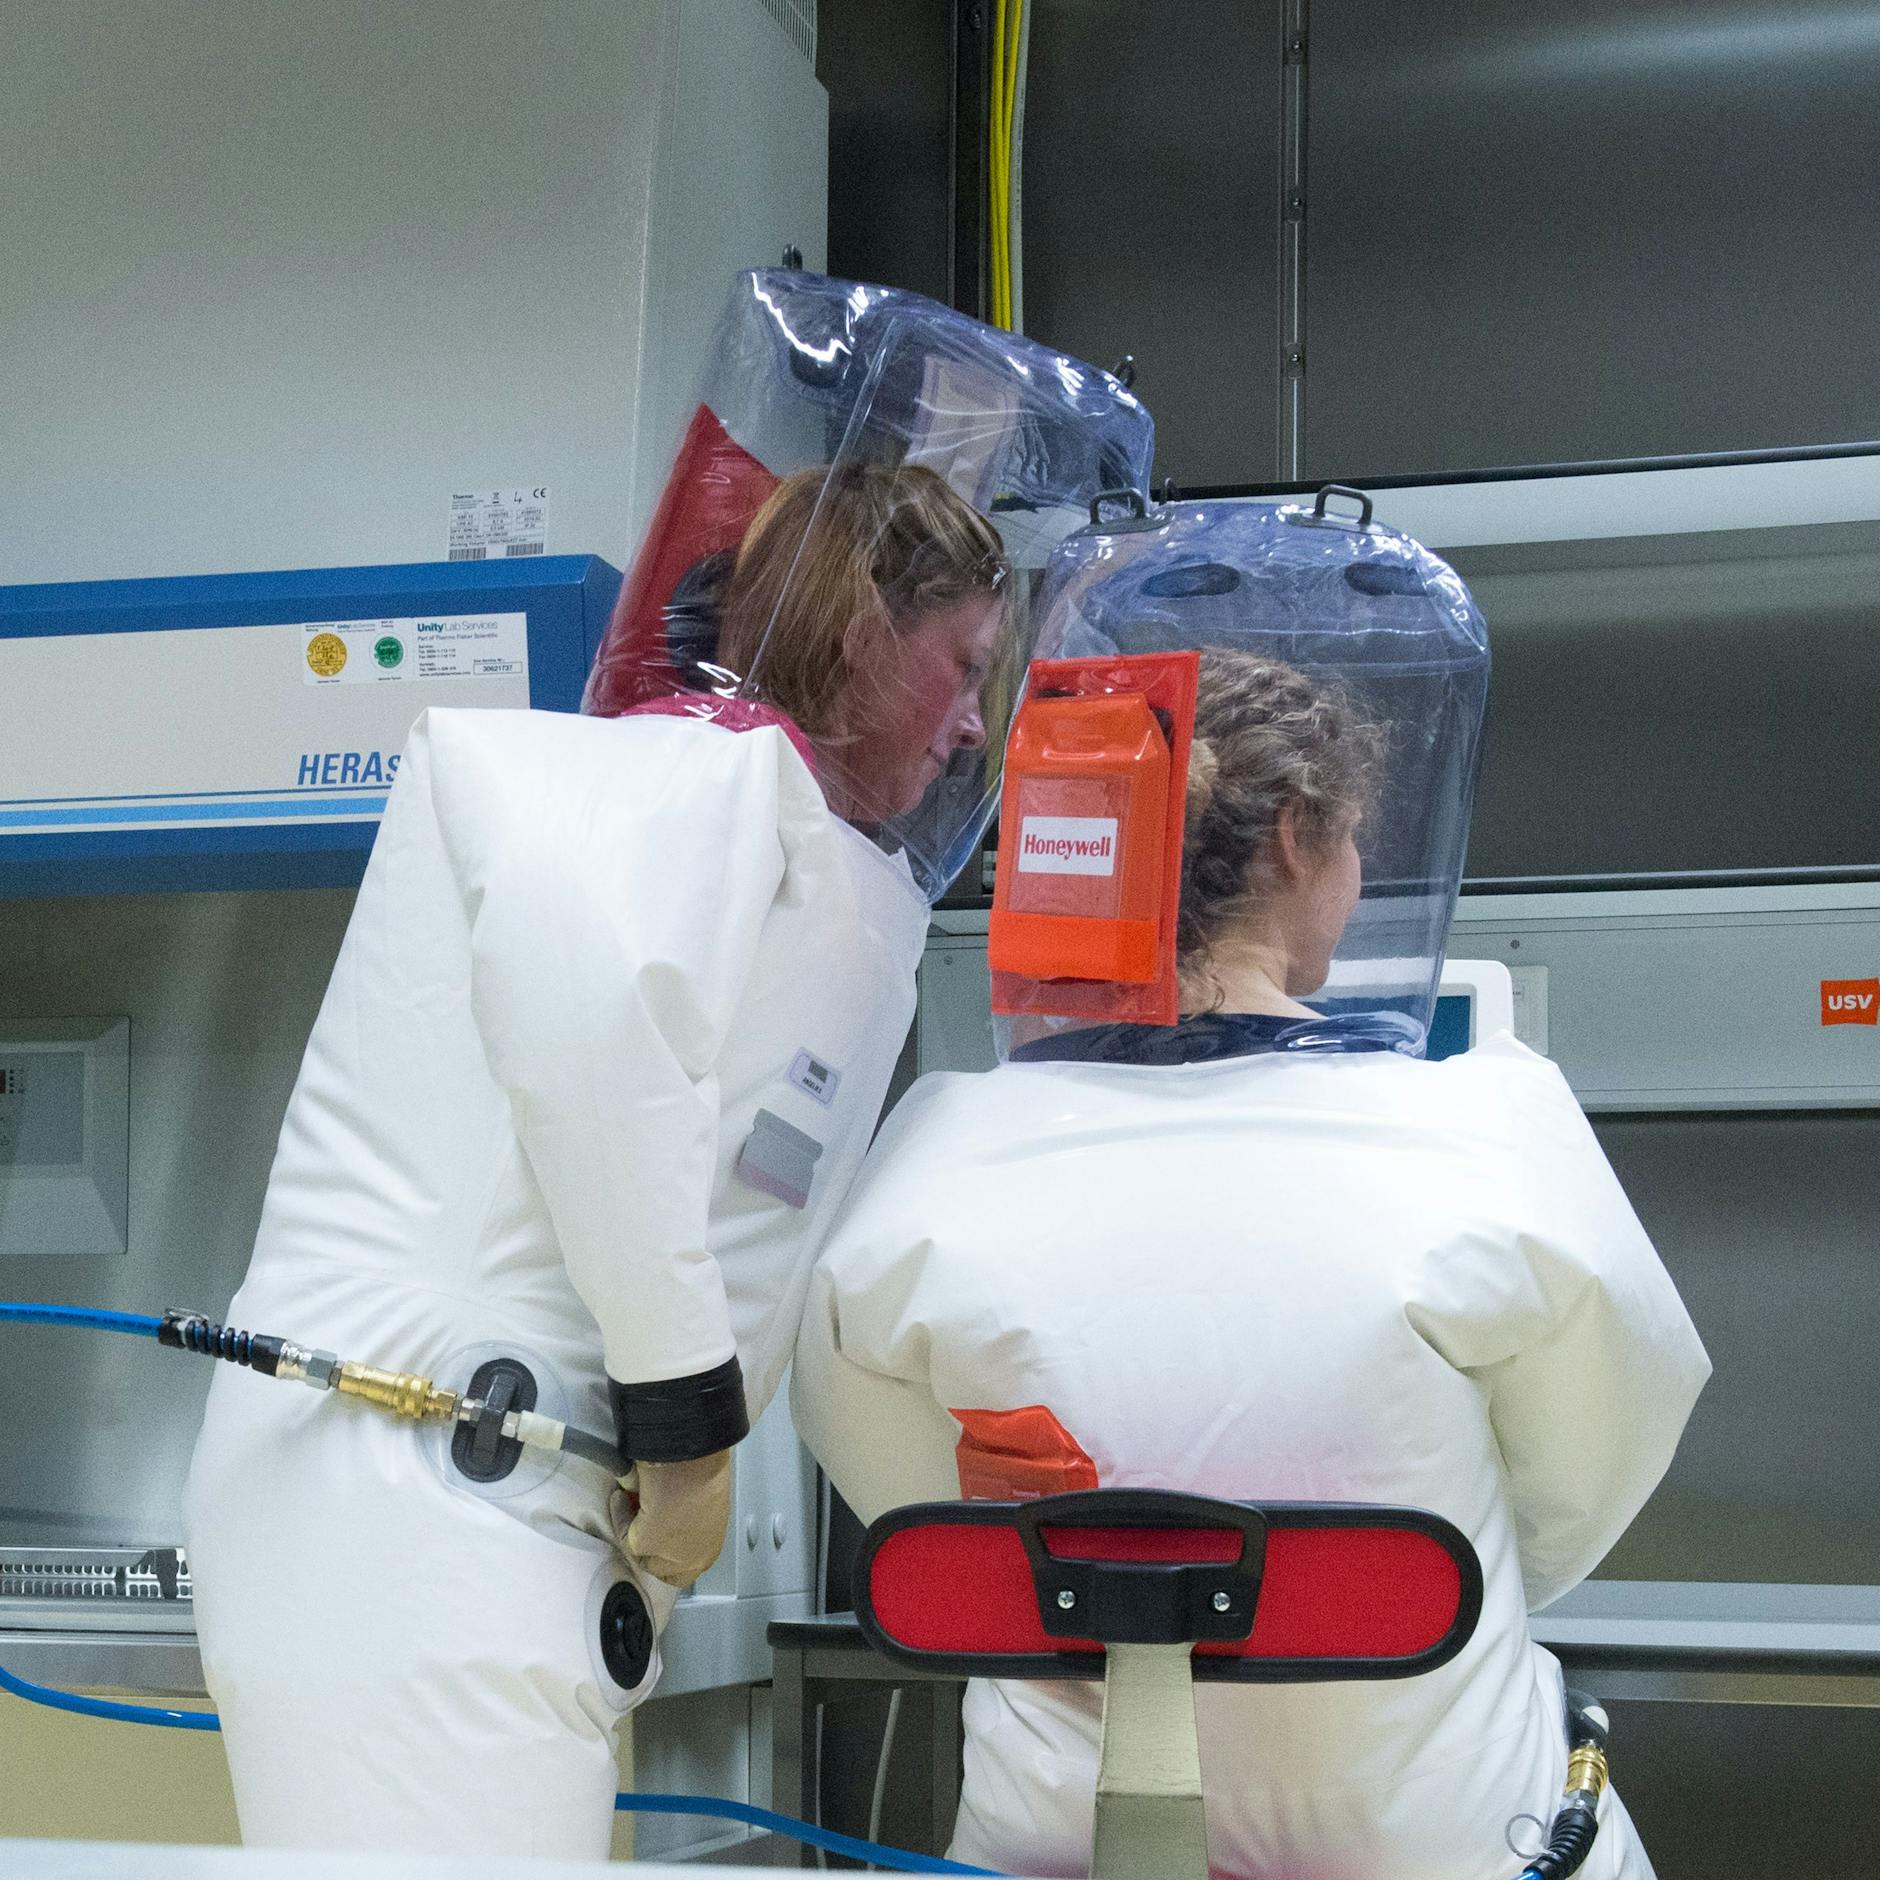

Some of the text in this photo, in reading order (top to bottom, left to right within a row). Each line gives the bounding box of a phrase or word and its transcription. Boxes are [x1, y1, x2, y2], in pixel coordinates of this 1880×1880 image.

[417, 623, 444, 633] Unity
[462, 621, 498, 630] Services
[298, 751, 401, 785] HERAS
[1024, 834, 1112, 860] Honeywell
[1828, 994, 1873, 1010] USV
